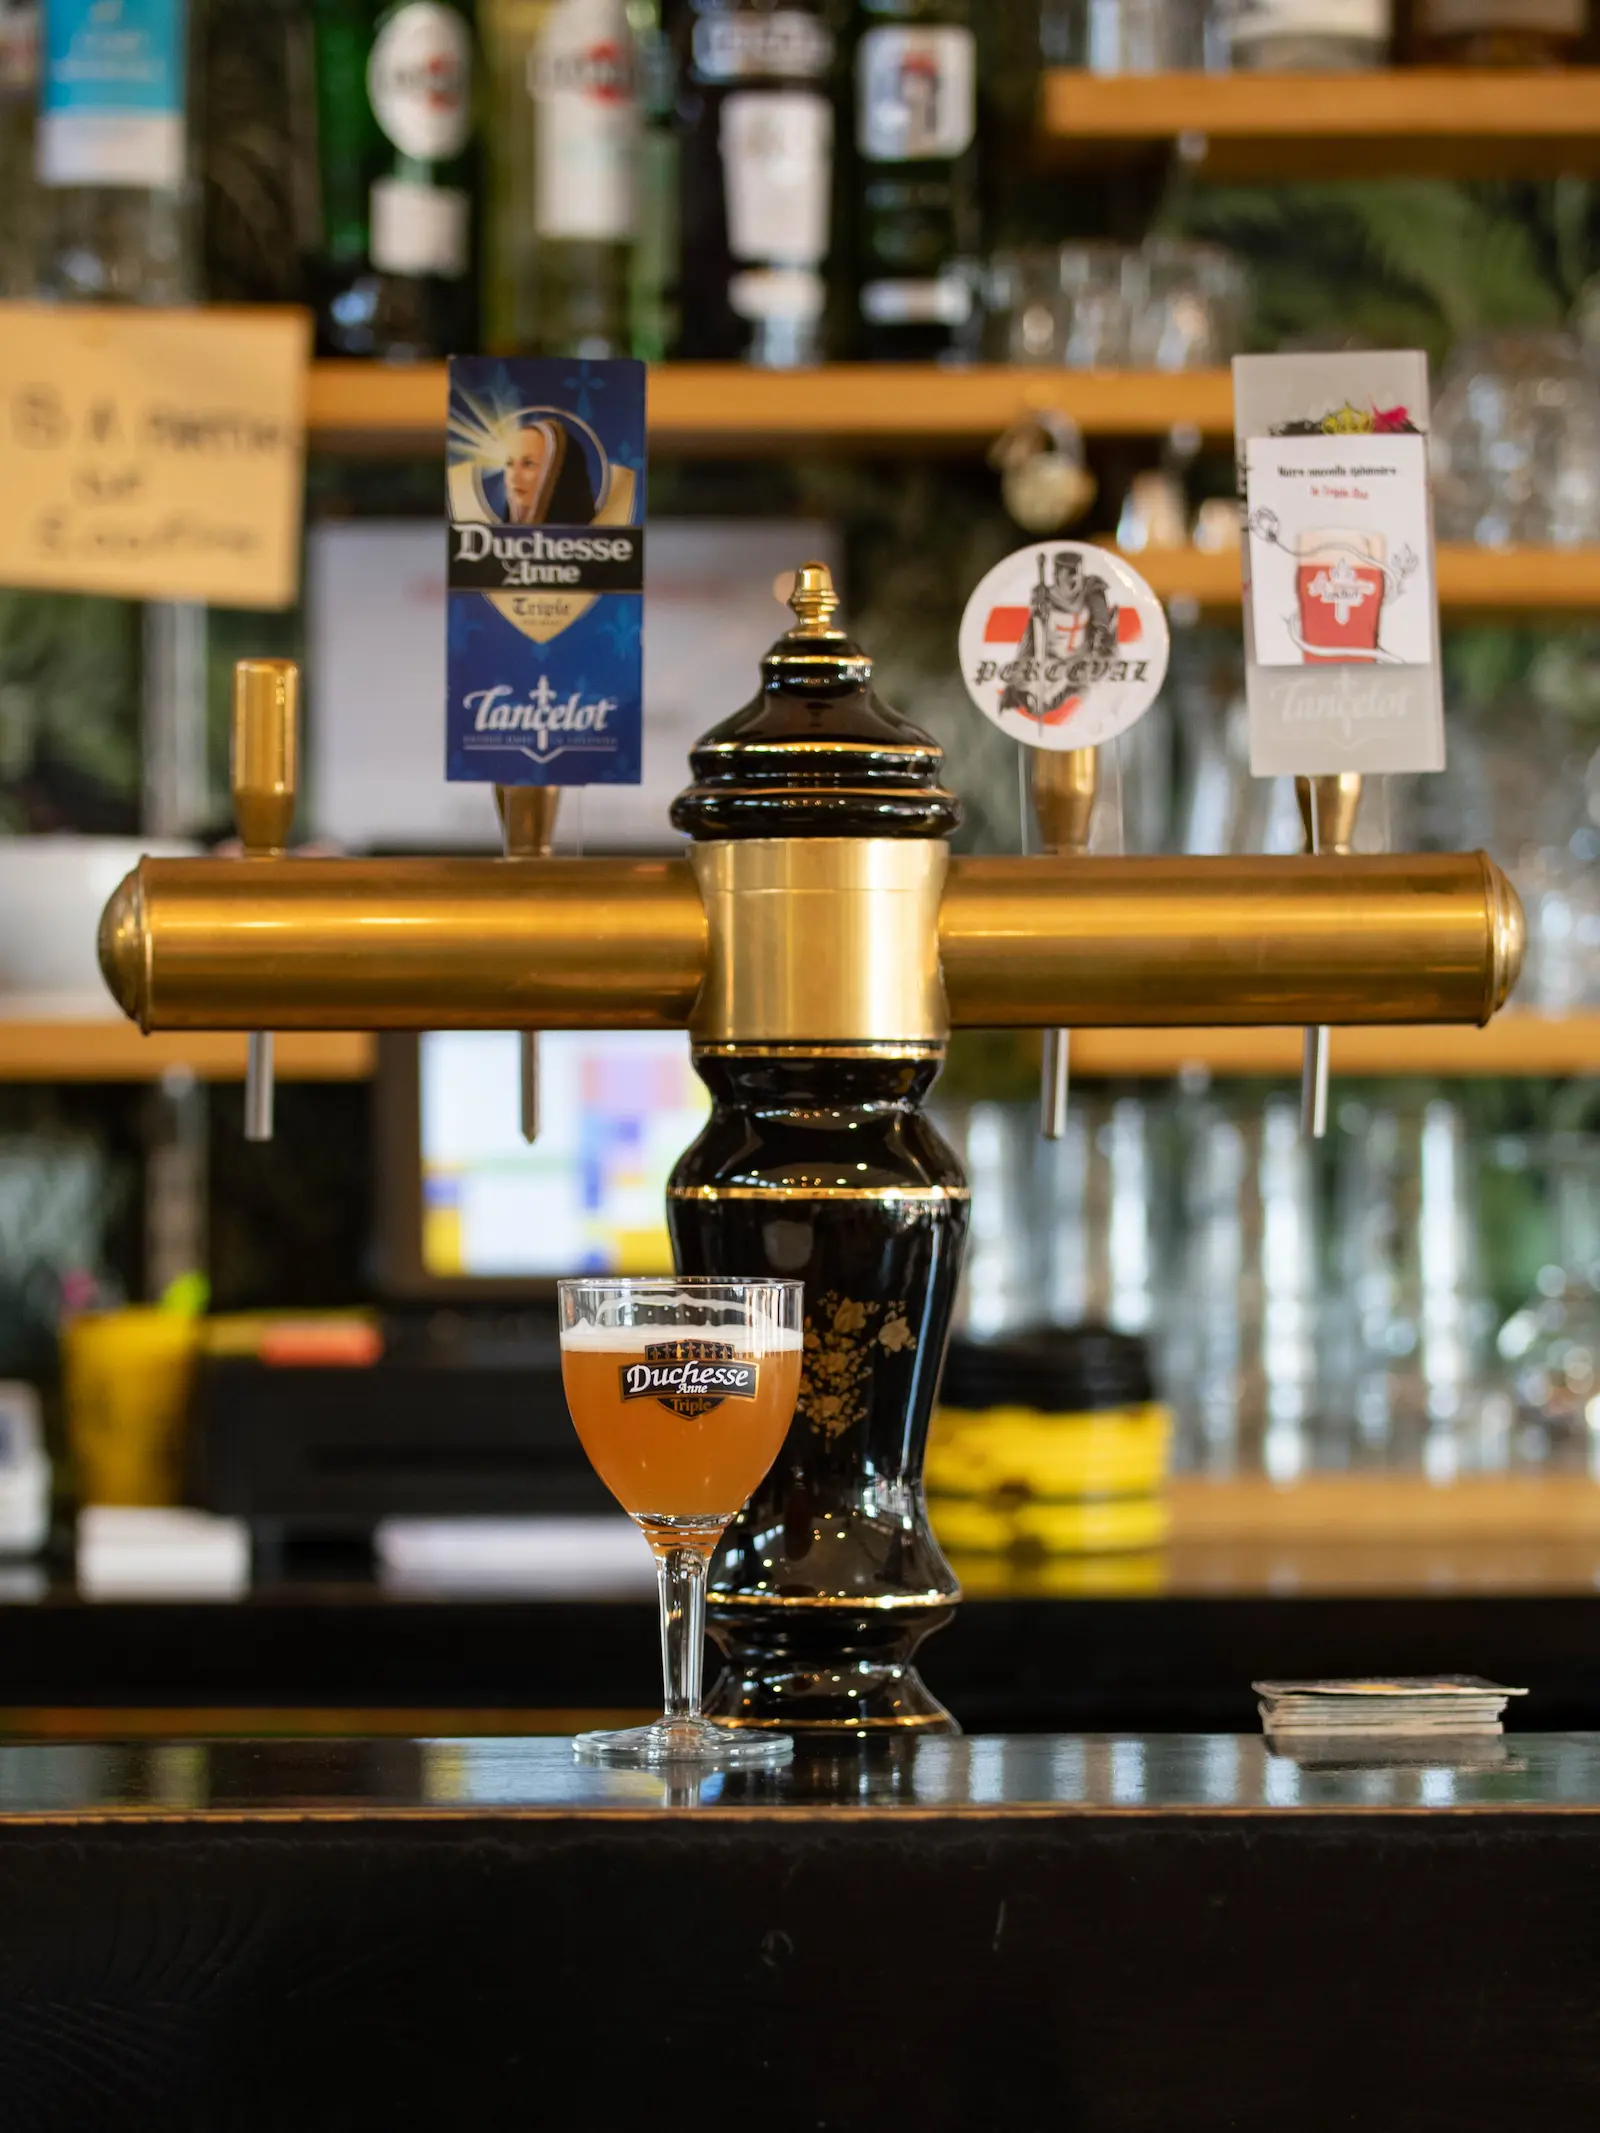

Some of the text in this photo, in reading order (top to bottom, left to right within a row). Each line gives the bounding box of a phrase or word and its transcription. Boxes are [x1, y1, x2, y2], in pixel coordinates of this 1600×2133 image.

[452, 523, 633, 562] Duchesse
[501, 560, 580, 585] Anne
[974, 660, 1150, 685] PERCEVAL
[626, 1360, 749, 1393] Duchesse
[676, 1382, 708, 1394] Anne
[670, 1398, 712, 1414] Triple
